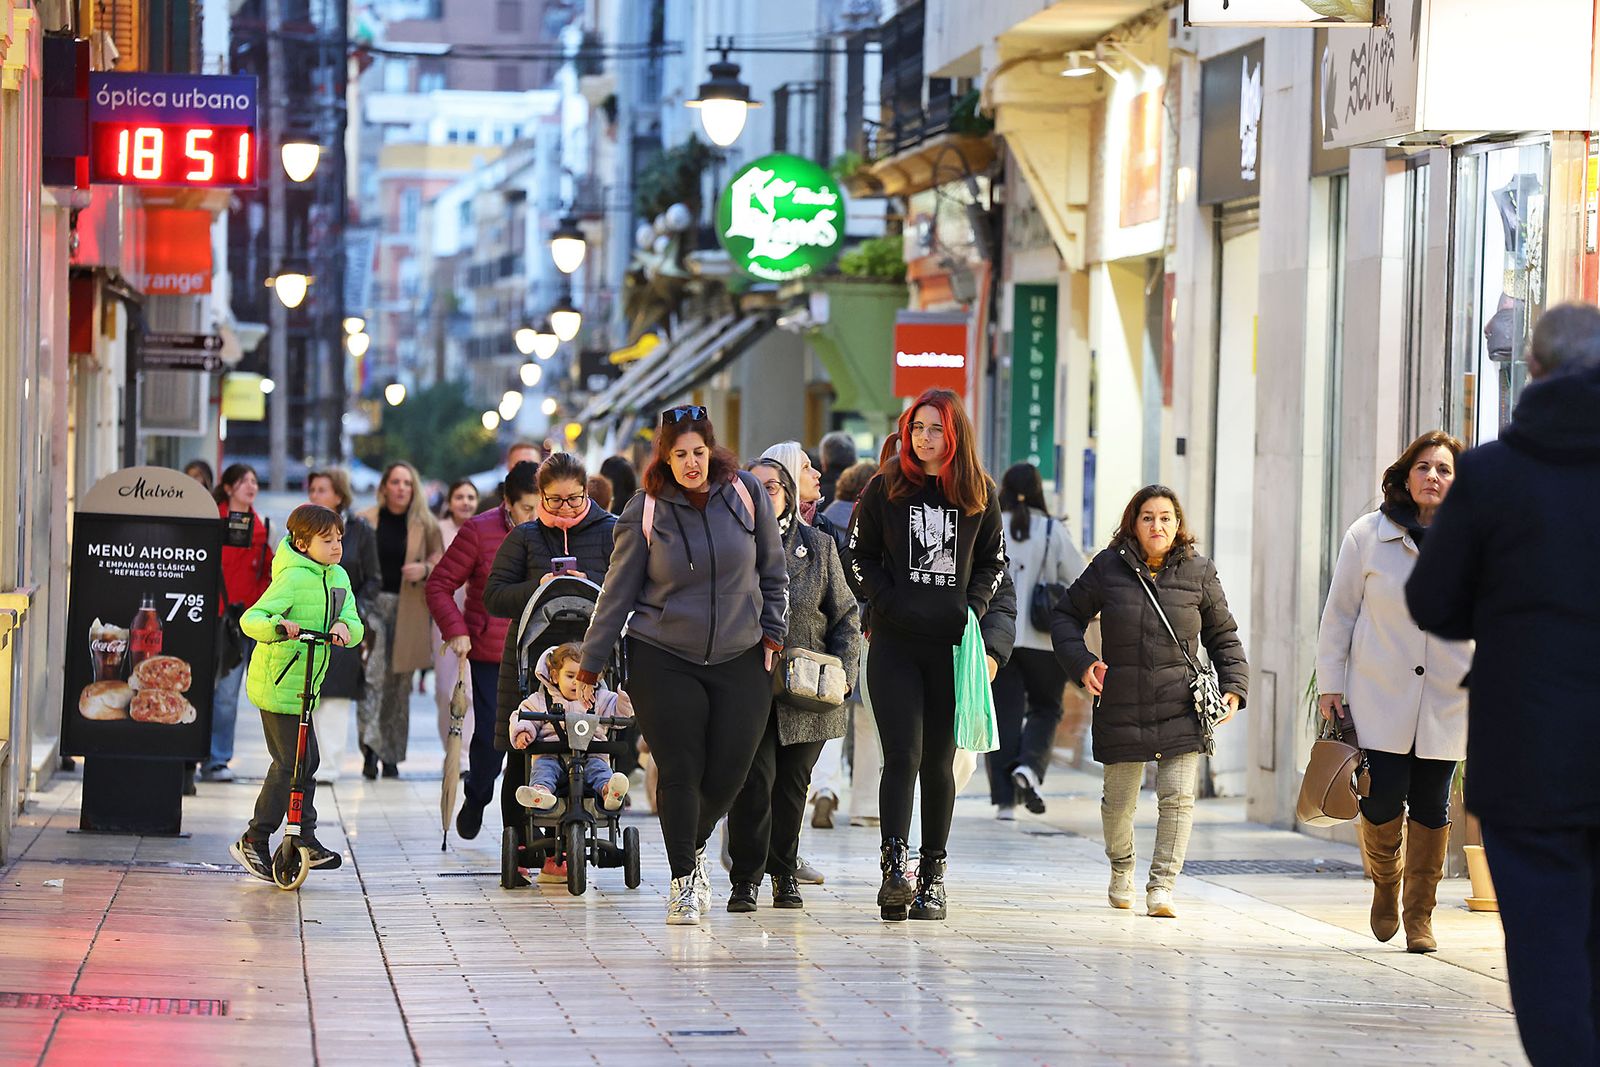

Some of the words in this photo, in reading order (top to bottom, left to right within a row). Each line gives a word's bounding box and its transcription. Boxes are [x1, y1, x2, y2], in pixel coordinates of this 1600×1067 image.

[96, 83, 166, 110] óptica
[172, 88, 250, 110] urbano
[143, 273, 204, 293] range
[1027, 296, 1047, 468] Herbolario
[118, 477, 184, 500] Malvón
[88, 543, 135, 558] MENÚ
[140, 546, 208, 561] AHORRO
[98, 560, 105, 568] 2
[106, 560, 154, 570] EMPANADAS
[156, 562, 196, 572] CLÁSICAS
[114, 568, 156, 578] REFRESCO
[158, 571, 184, 579] 500ml
